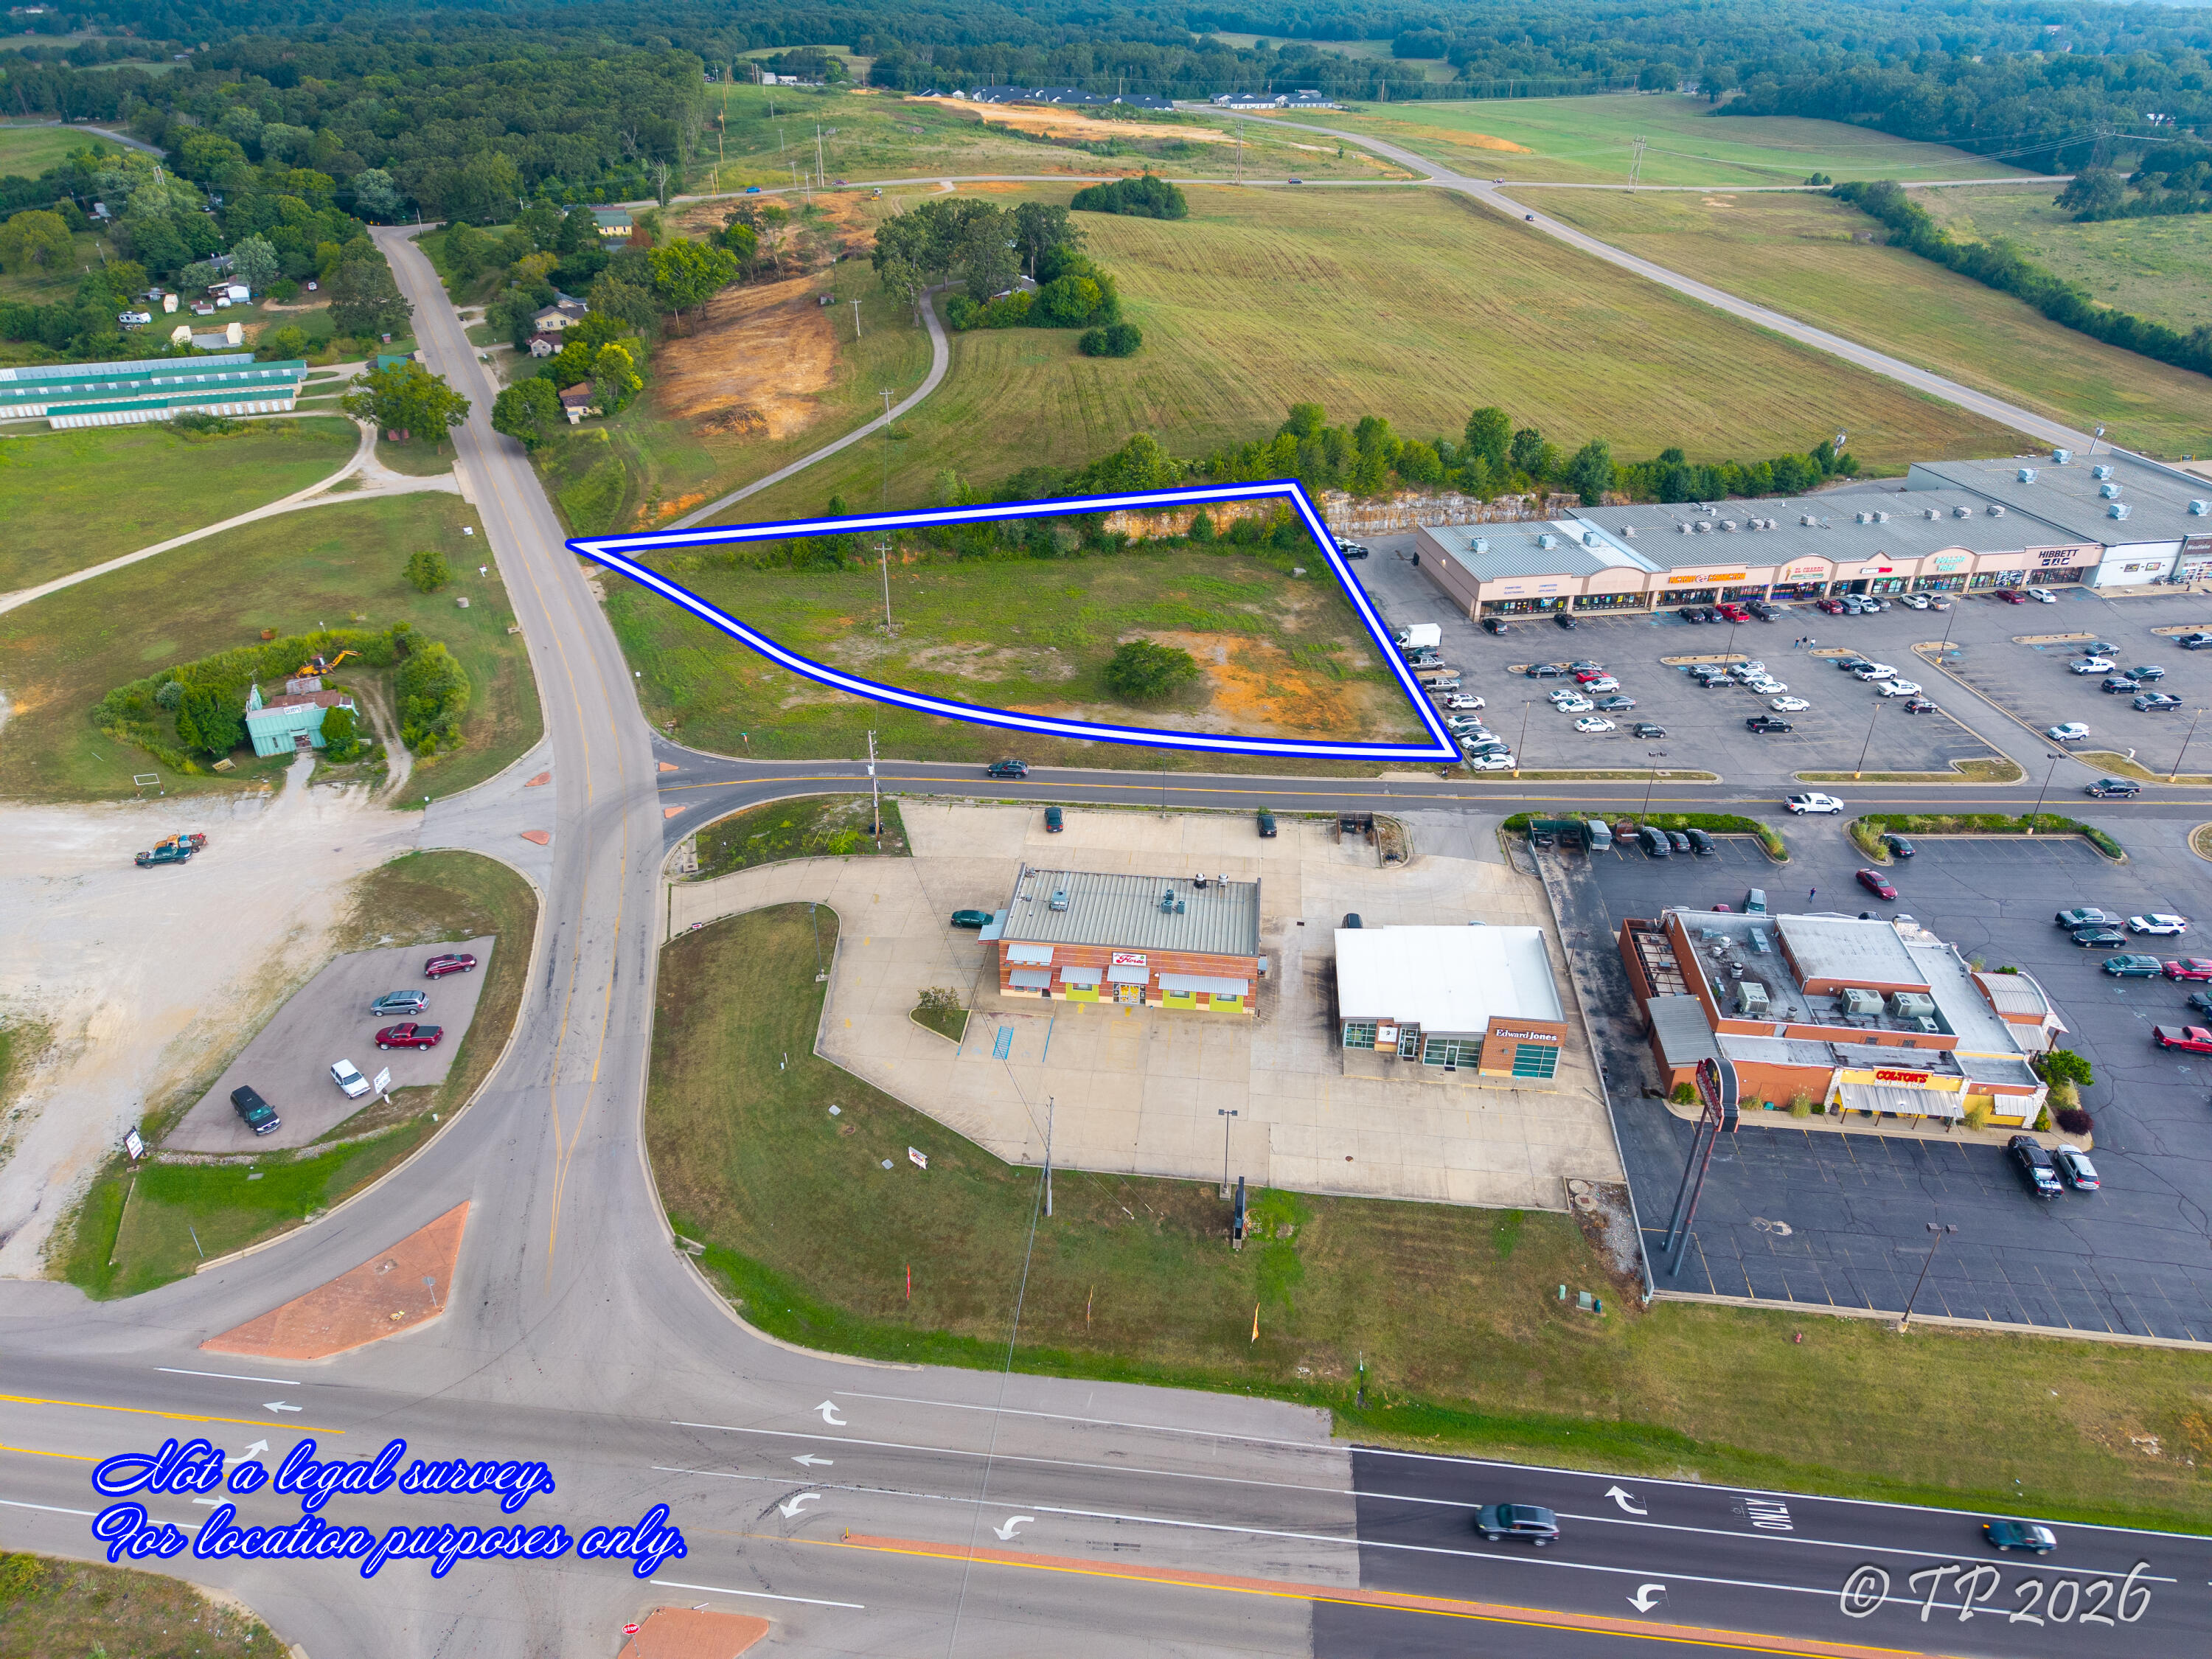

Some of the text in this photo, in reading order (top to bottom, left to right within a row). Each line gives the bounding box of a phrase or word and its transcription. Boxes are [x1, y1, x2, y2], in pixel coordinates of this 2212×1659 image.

[1934, 555, 1966, 564] DOLLAR
[2038, 549, 2080, 558] HIBBETT
[1937, 564, 1957, 572] TREE
[1669, 575, 1697, 584] FACTORY
[1708, 572, 1746, 582] CONNECTION
[1495, 1029, 1557, 1041] Edward Jones
[1877, 1070, 1929, 1083] COLTON'S
[1744, 1498, 1794, 1530] ONLY
